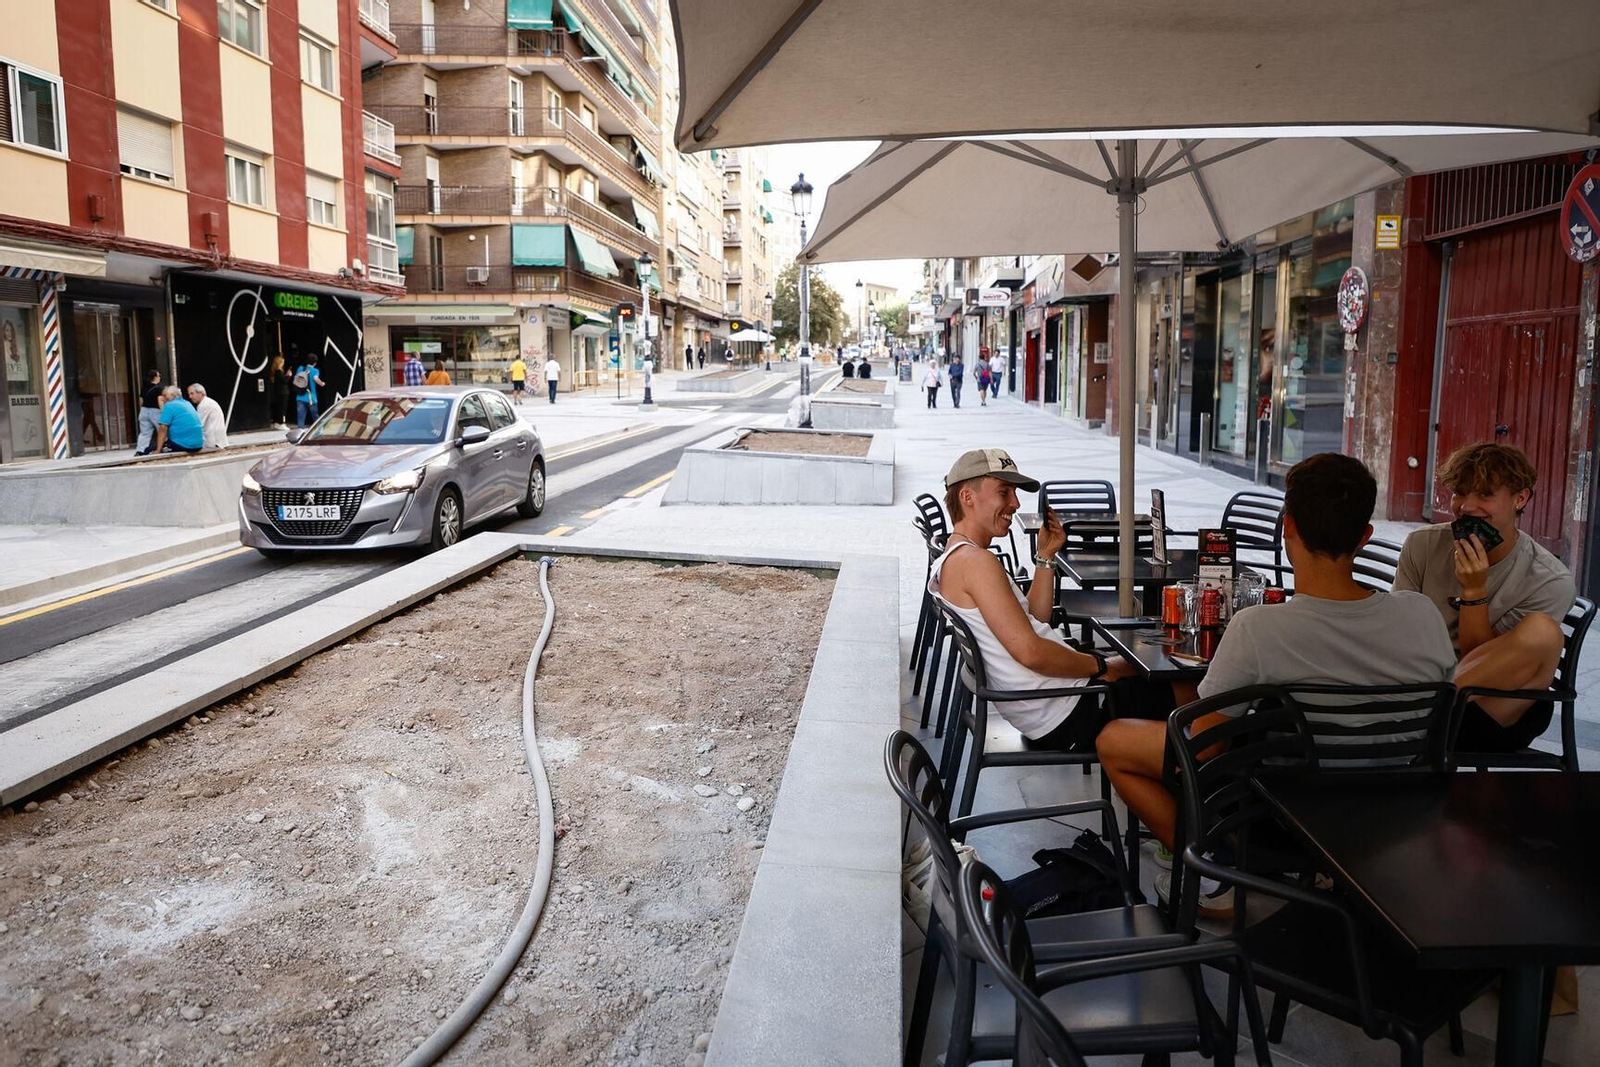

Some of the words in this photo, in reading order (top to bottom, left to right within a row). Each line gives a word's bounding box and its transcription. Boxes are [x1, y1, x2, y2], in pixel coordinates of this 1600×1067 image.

[275, 292, 319, 311] ORENES
[11, 397, 40, 406] BARBER
[286, 507, 313, 518] 2175
[315, 507, 337, 518] LRF
[1206, 543, 1230, 552] ALWAYS
